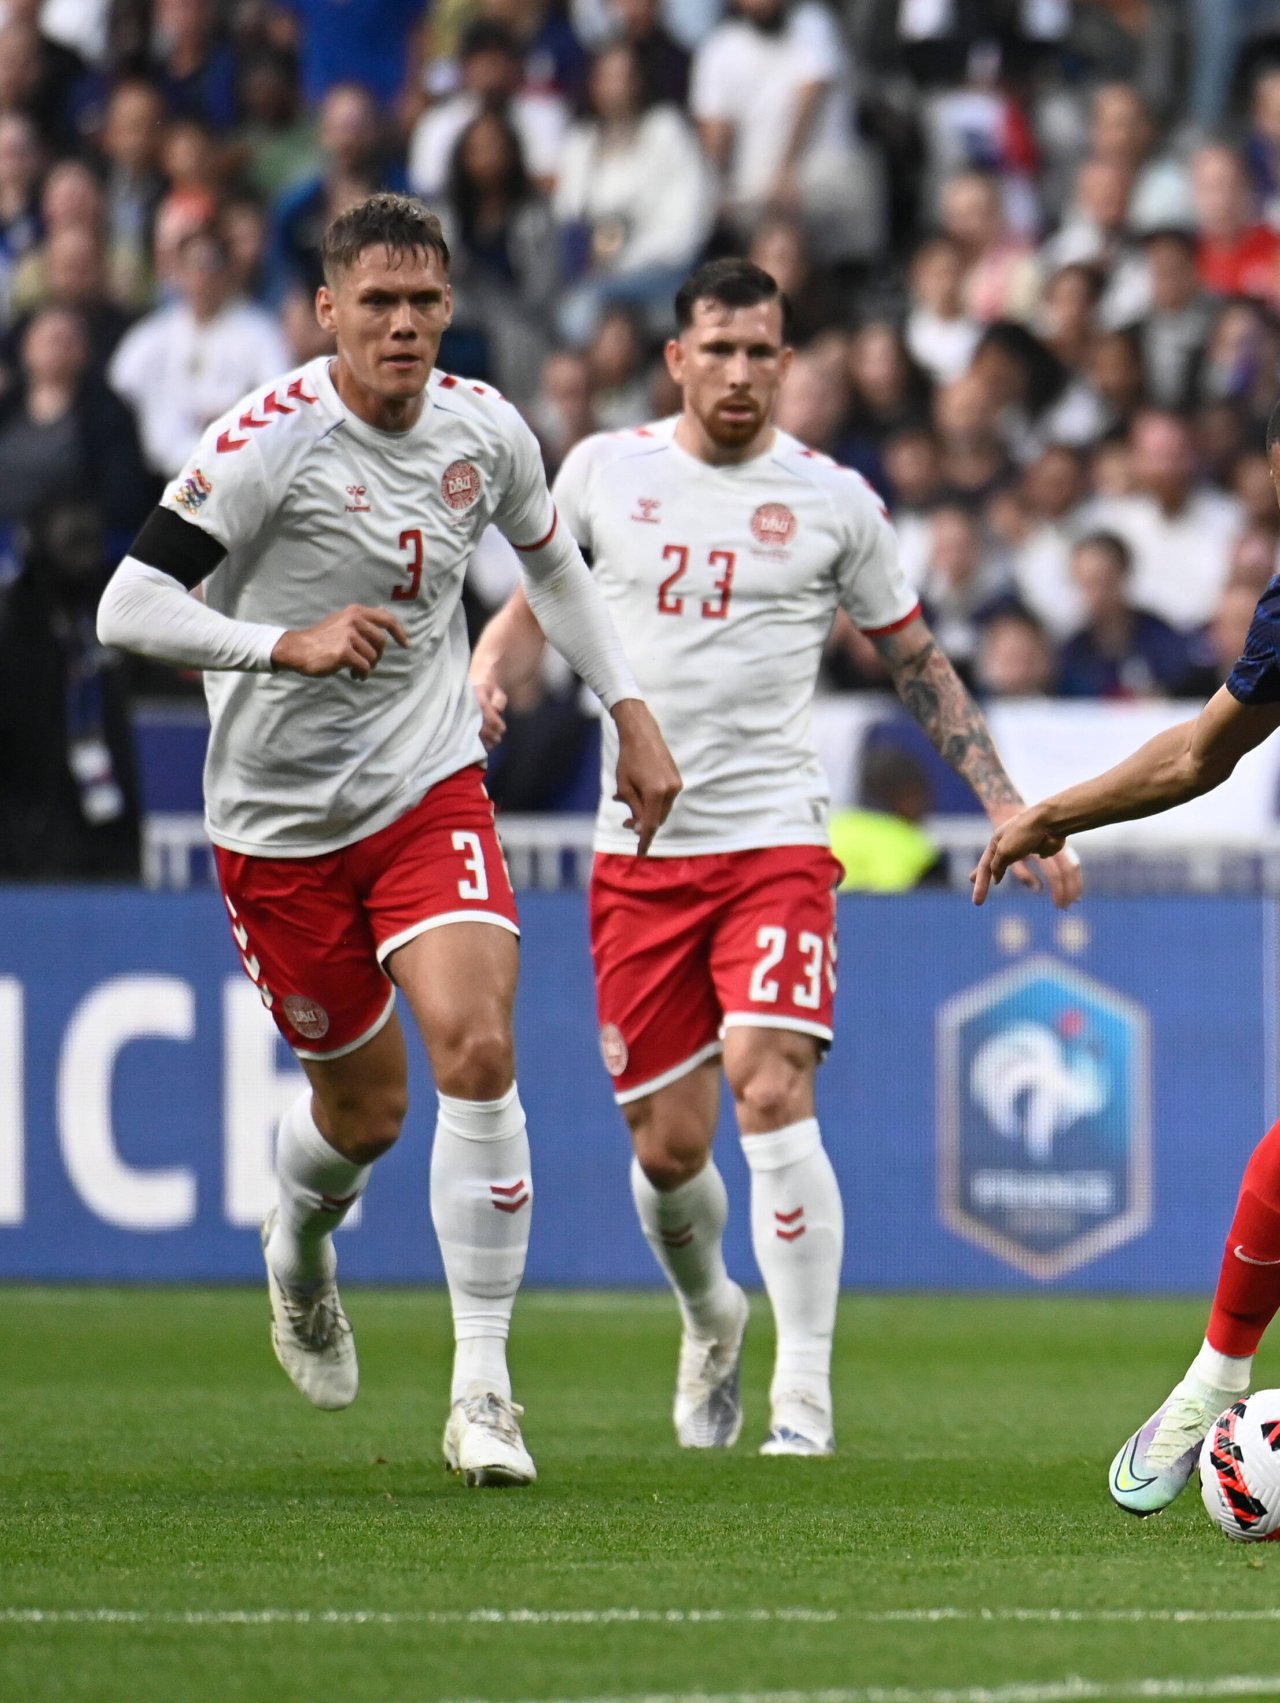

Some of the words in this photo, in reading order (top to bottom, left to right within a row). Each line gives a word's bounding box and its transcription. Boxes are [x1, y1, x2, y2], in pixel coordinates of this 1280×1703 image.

[391, 530, 423, 600] 3
[658, 544, 736, 619] 23
[451, 830, 489, 900] 3
[749, 925, 823, 1010] 23
